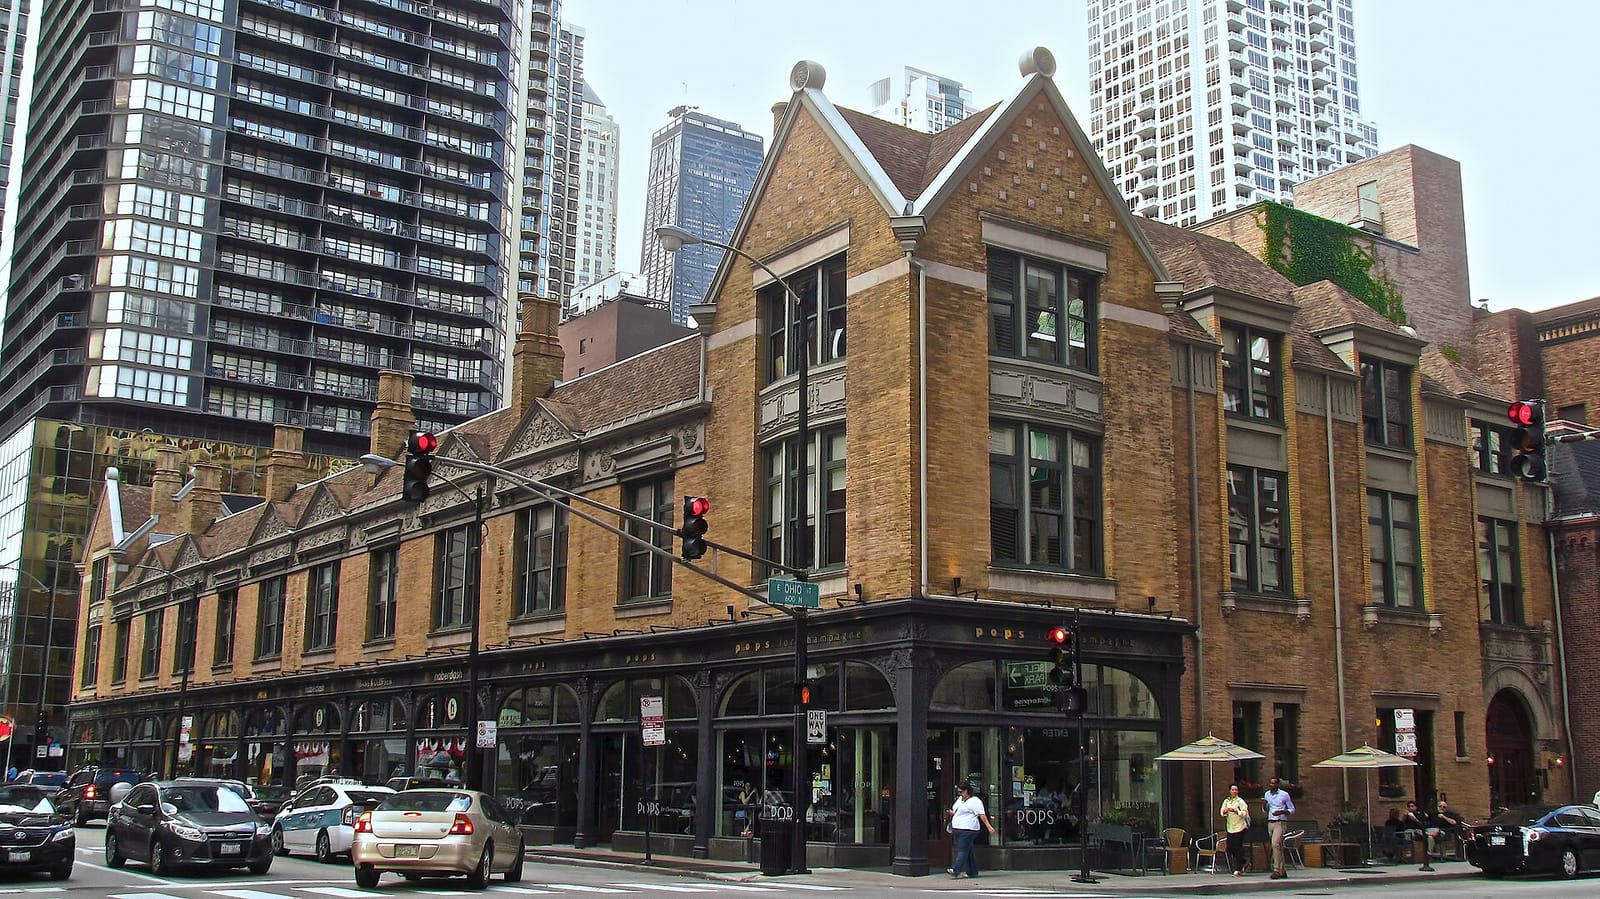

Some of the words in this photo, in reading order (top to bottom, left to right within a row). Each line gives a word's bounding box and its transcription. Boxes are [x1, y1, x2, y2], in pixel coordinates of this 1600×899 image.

[784, 583, 803, 595] OHIO
[784, 595, 796, 603] 600
[975, 626, 1025, 641] pops
[735, 640, 771, 653] pops
[806, 631, 861, 645] hampagne
[626, 653, 656, 664] pops
[522, 661, 545, 671] pops
[809, 712, 824, 720] ONE
[809, 721, 824, 729] WAY
[637, 801, 660, 816] POPS
[1016, 810, 1055, 825] POPS
